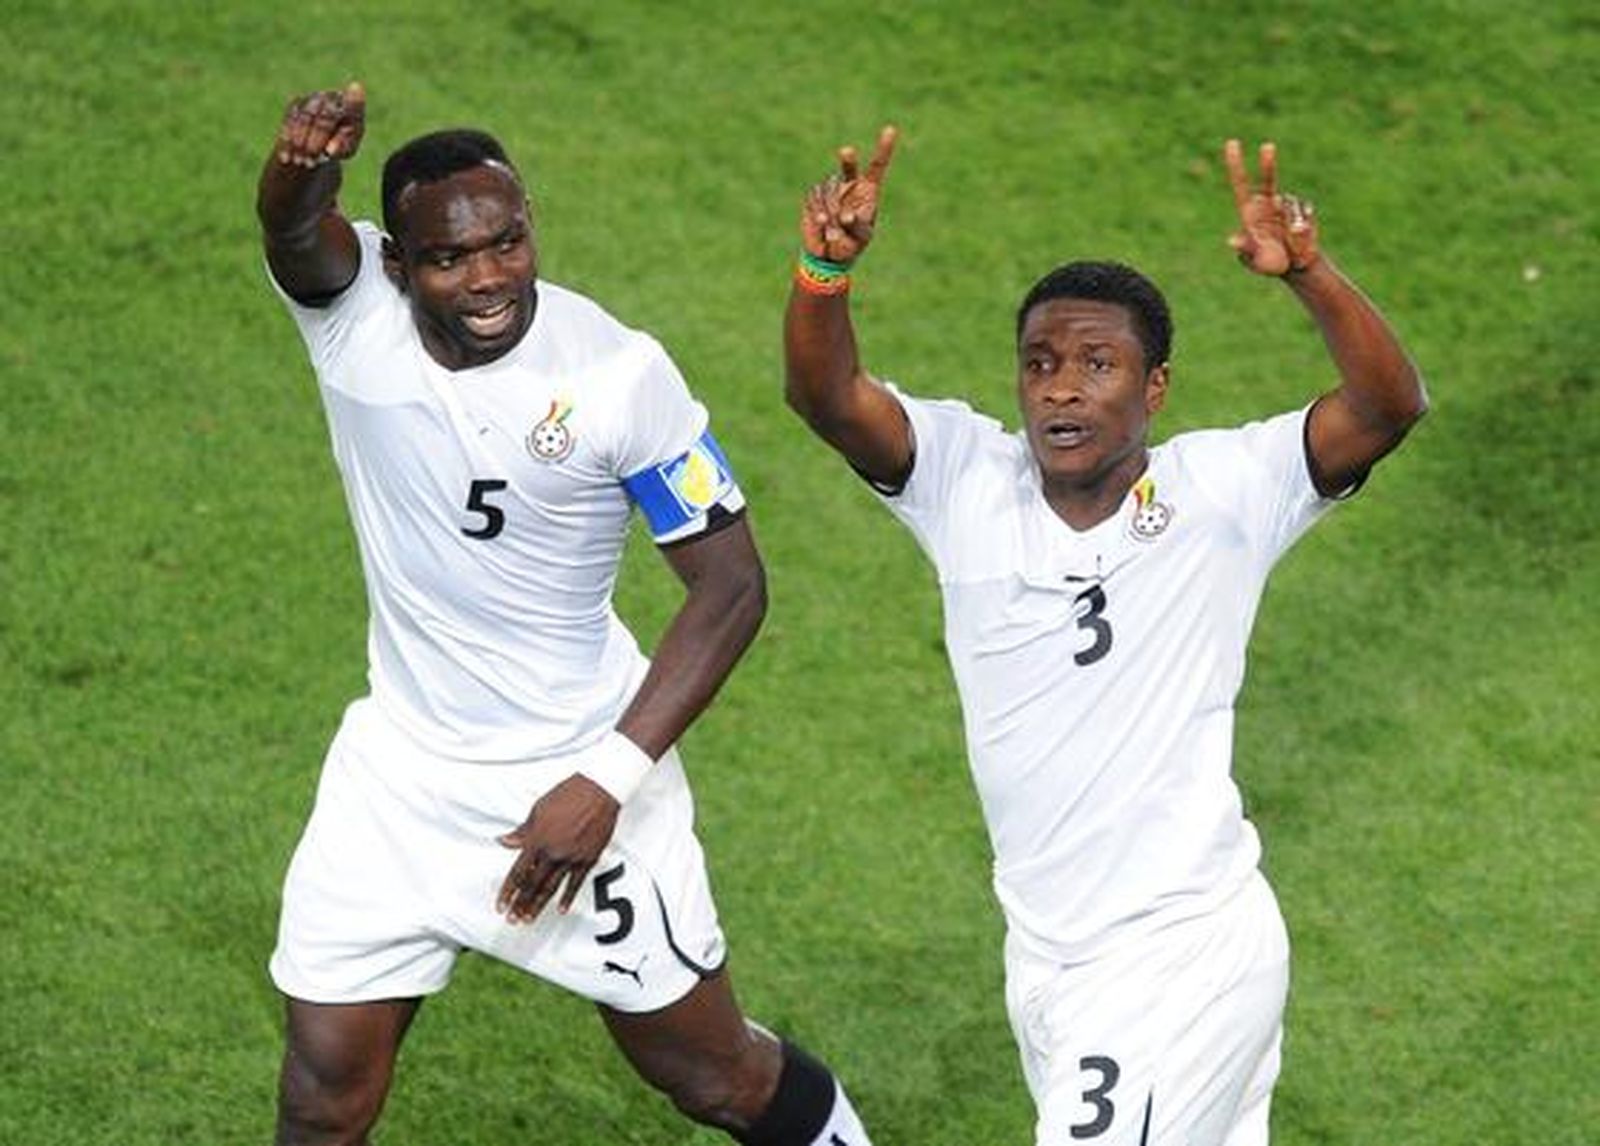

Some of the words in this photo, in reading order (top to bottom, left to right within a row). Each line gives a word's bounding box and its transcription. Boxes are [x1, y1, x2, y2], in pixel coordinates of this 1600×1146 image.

[460, 479, 508, 541] 5
[1073, 584, 1113, 667] 3
[593, 862, 635, 945] 5
[1070, 1055, 1121, 1139] 3
